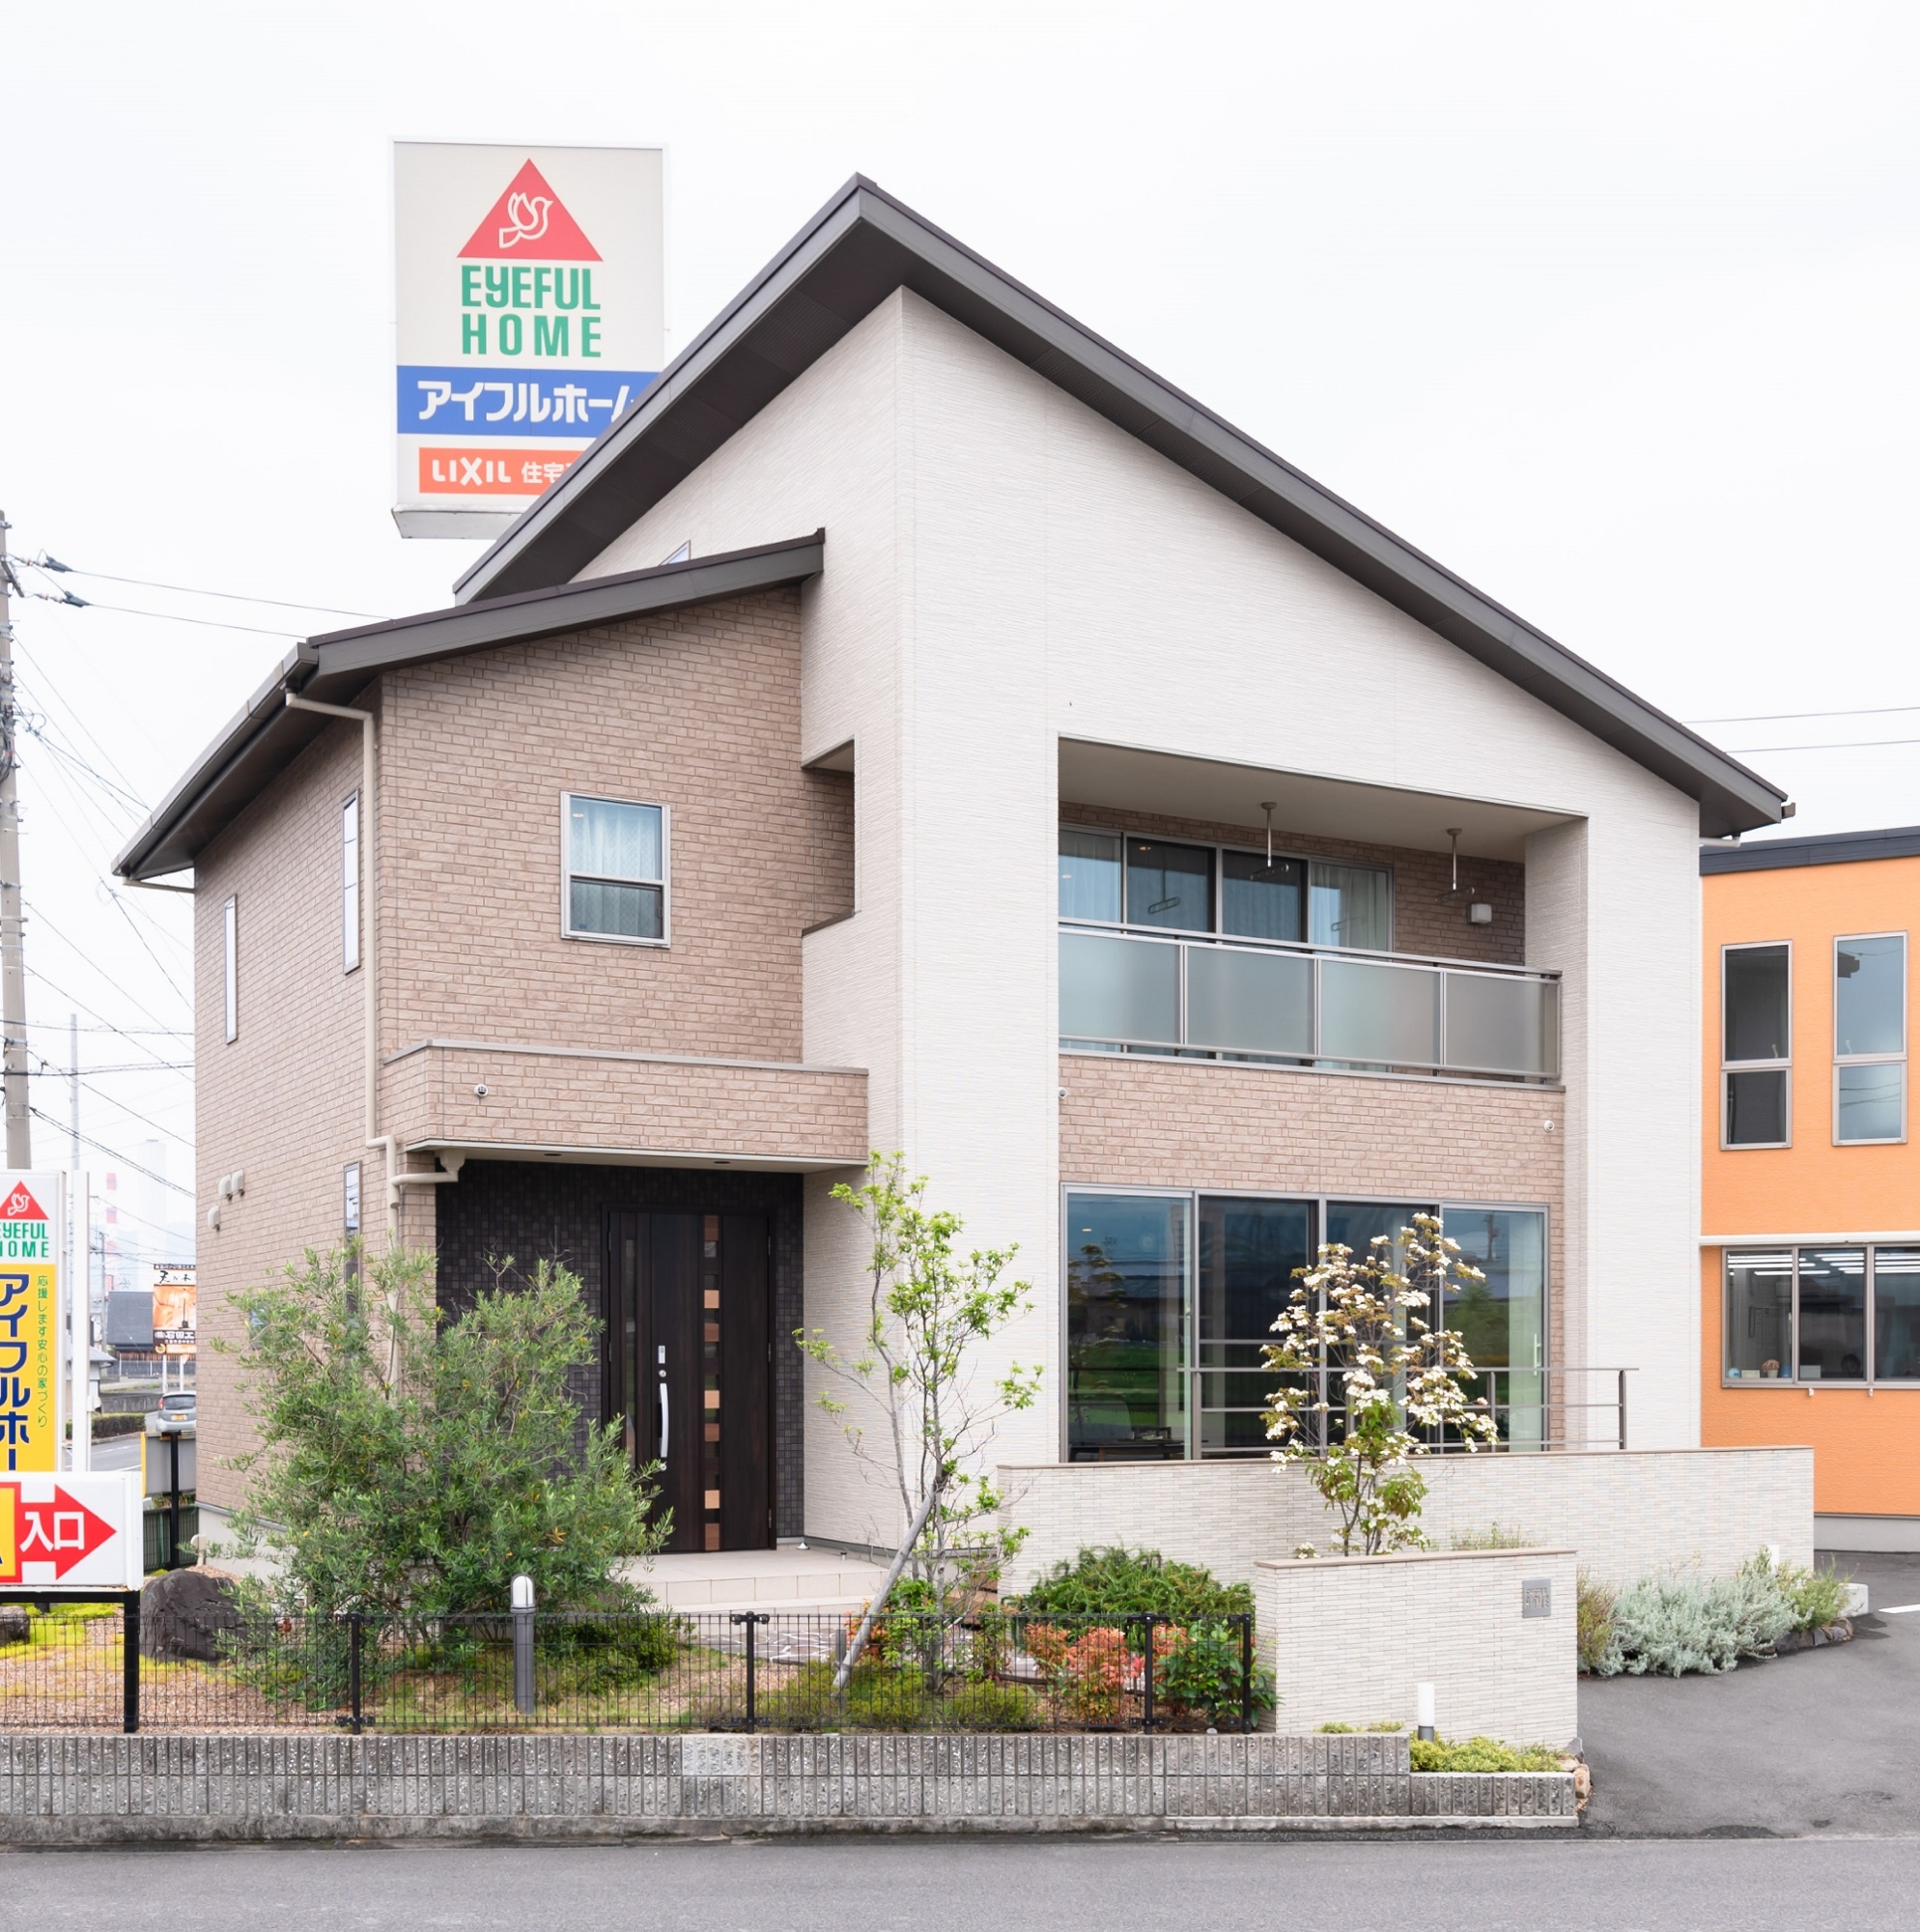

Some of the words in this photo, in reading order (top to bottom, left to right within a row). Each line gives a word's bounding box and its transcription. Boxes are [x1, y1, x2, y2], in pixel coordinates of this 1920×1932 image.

[461, 265, 601, 310] EYEFUL
[462, 313, 602, 357] HOME
[432, 457, 511, 487] LIXIL
[522, 462, 572, 484] 住宅
[0, 1222, 49, 1239] YEFUL
[37, 1275, 48, 1428] 応援します安心の家づくり
[19, 1511, 85, 1552] 入口
